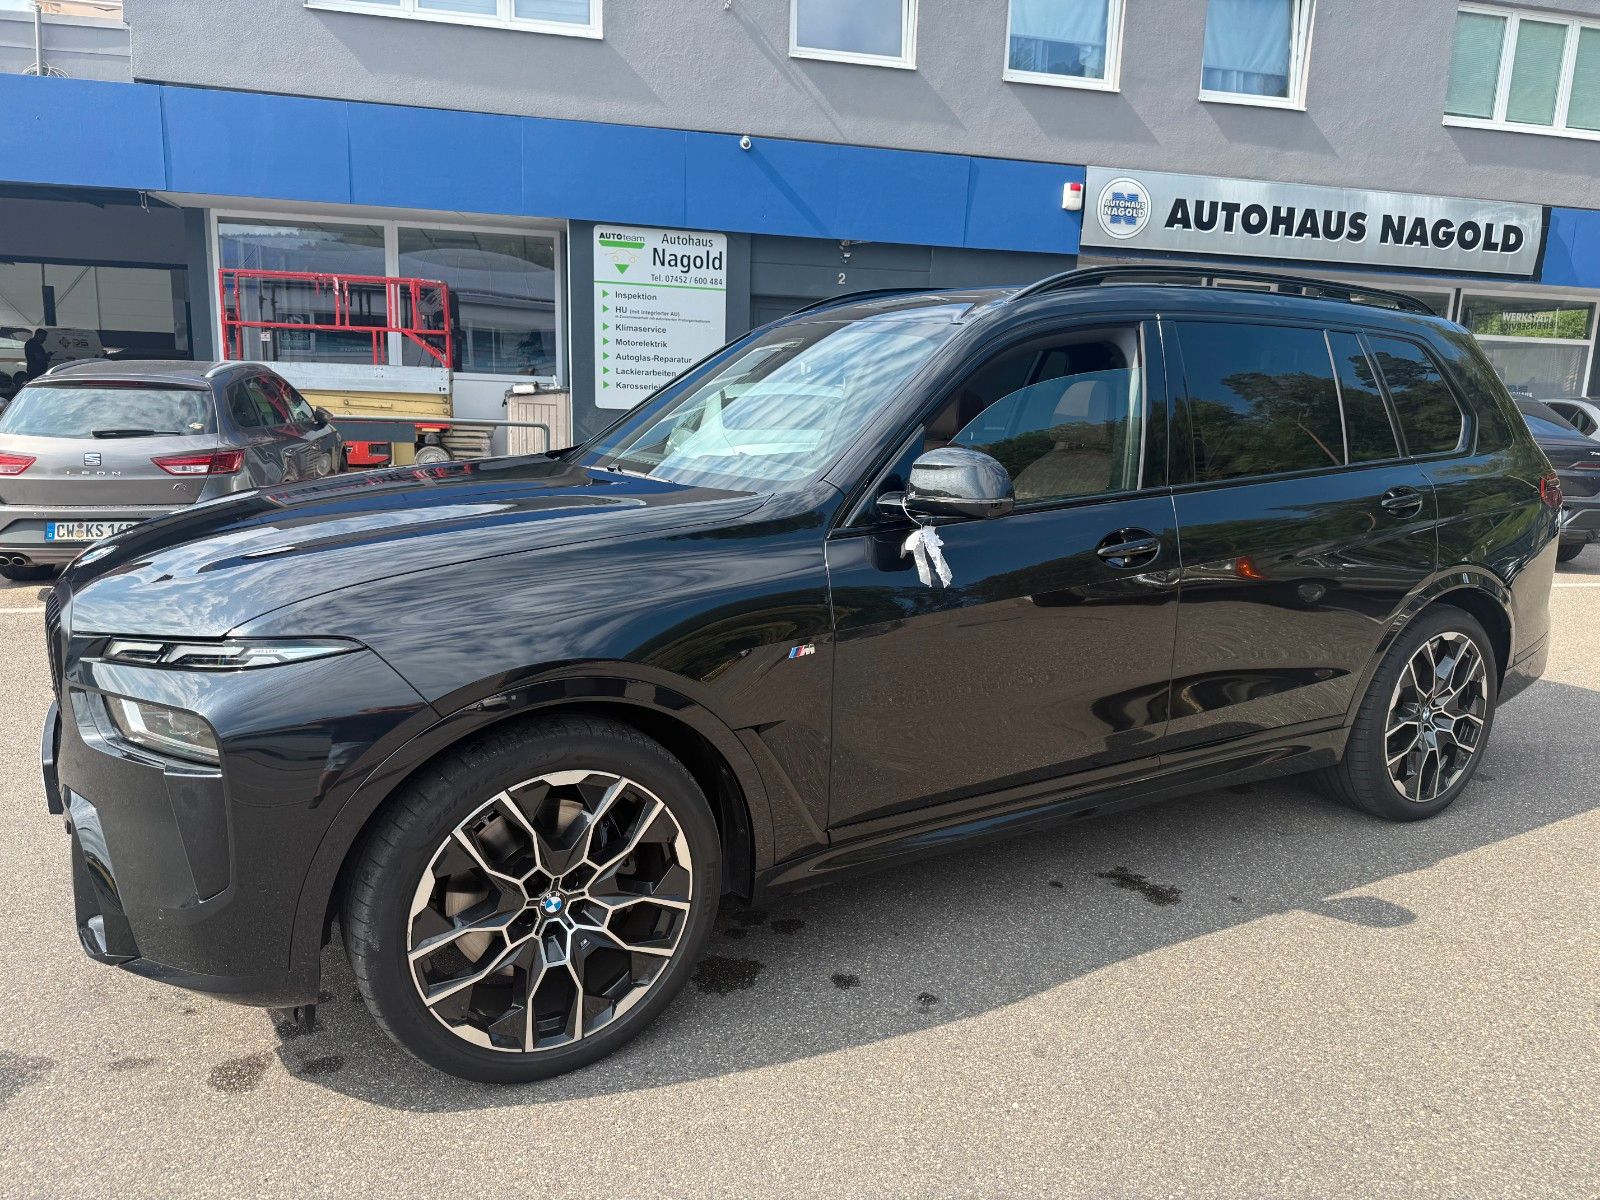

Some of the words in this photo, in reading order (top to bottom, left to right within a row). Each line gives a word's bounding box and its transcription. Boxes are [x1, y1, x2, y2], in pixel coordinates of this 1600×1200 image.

[1104, 199, 1146, 209] AUTOHAUS
[1104, 206, 1145, 218] NAGOLD
[1164, 198, 1367, 244] AUTOHAUS
[1379, 213, 1525, 255] NAGOLD
[599, 232, 645, 242] AUTOteam
[661, 233, 713, 248] Autohaus
[652, 247, 723, 274] Nagold
[651, 274, 663, 282] Tel.
[665, 275, 687, 284] 07452
[694, 276, 707, 285] 600
[710, 277, 723, 286] 484
[838, 272, 846, 285] 2
[615, 290, 657, 302] Inspektion
[615, 306, 627, 314] HU
[615, 323, 667, 334] Klimaservice
[615, 338, 668, 348] Motorelektrik
[615, 353, 692, 364] Autoglas-Reparatur
[615, 367, 677, 377] Lackierarbeiten
[615, 382, 664, 390] Karosseriei
[57, 523, 75, 538] CW
[86, 523, 104, 538] KS
